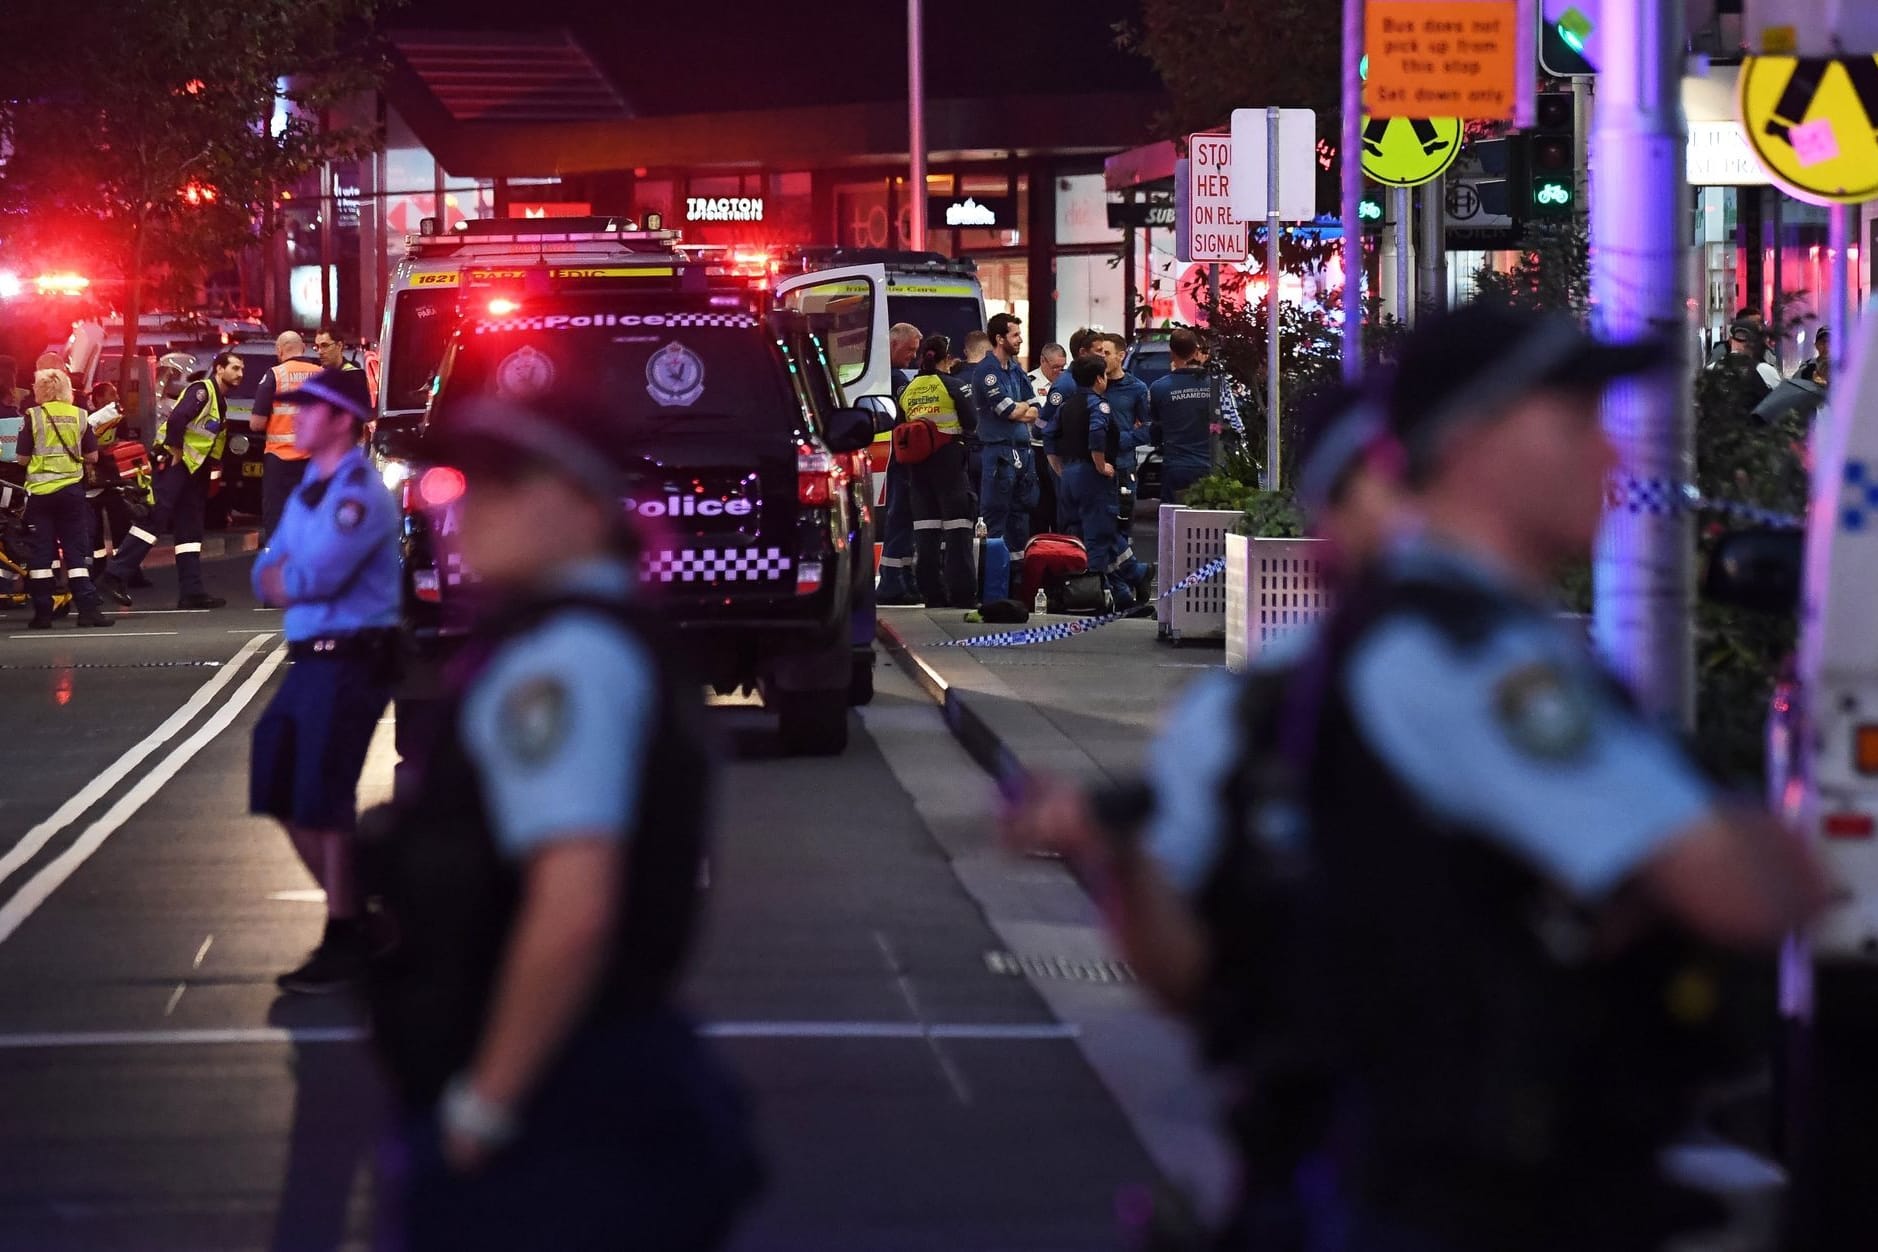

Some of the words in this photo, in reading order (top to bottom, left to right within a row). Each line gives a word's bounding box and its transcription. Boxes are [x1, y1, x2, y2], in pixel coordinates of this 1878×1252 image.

[1383, 17, 1414, 32] Bus
[1424, 18, 1462, 32] does
[1472, 19, 1500, 32] not
[1384, 39, 1418, 55] pick
[1428, 42, 1448, 54] up
[1456, 38, 1497, 53] from
[1402, 58, 1433, 73] this
[1444, 60, 1481, 75] stop
[1378, 85, 1405, 100] Set
[1415, 86, 1461, 100] down
[1469, 88, 1503, 103] only
[1198, 144, 1232, 166] STO
[1197, 175, 1229, 197] HER
[1145, 208, 1176, 223] SUB
[1195, 206, 1213, 224] ON
[1194, 234, 1243, 253] SIGNAL
[418, 274, 457, 284] 1621
[544, 313, 666, 328] Police
